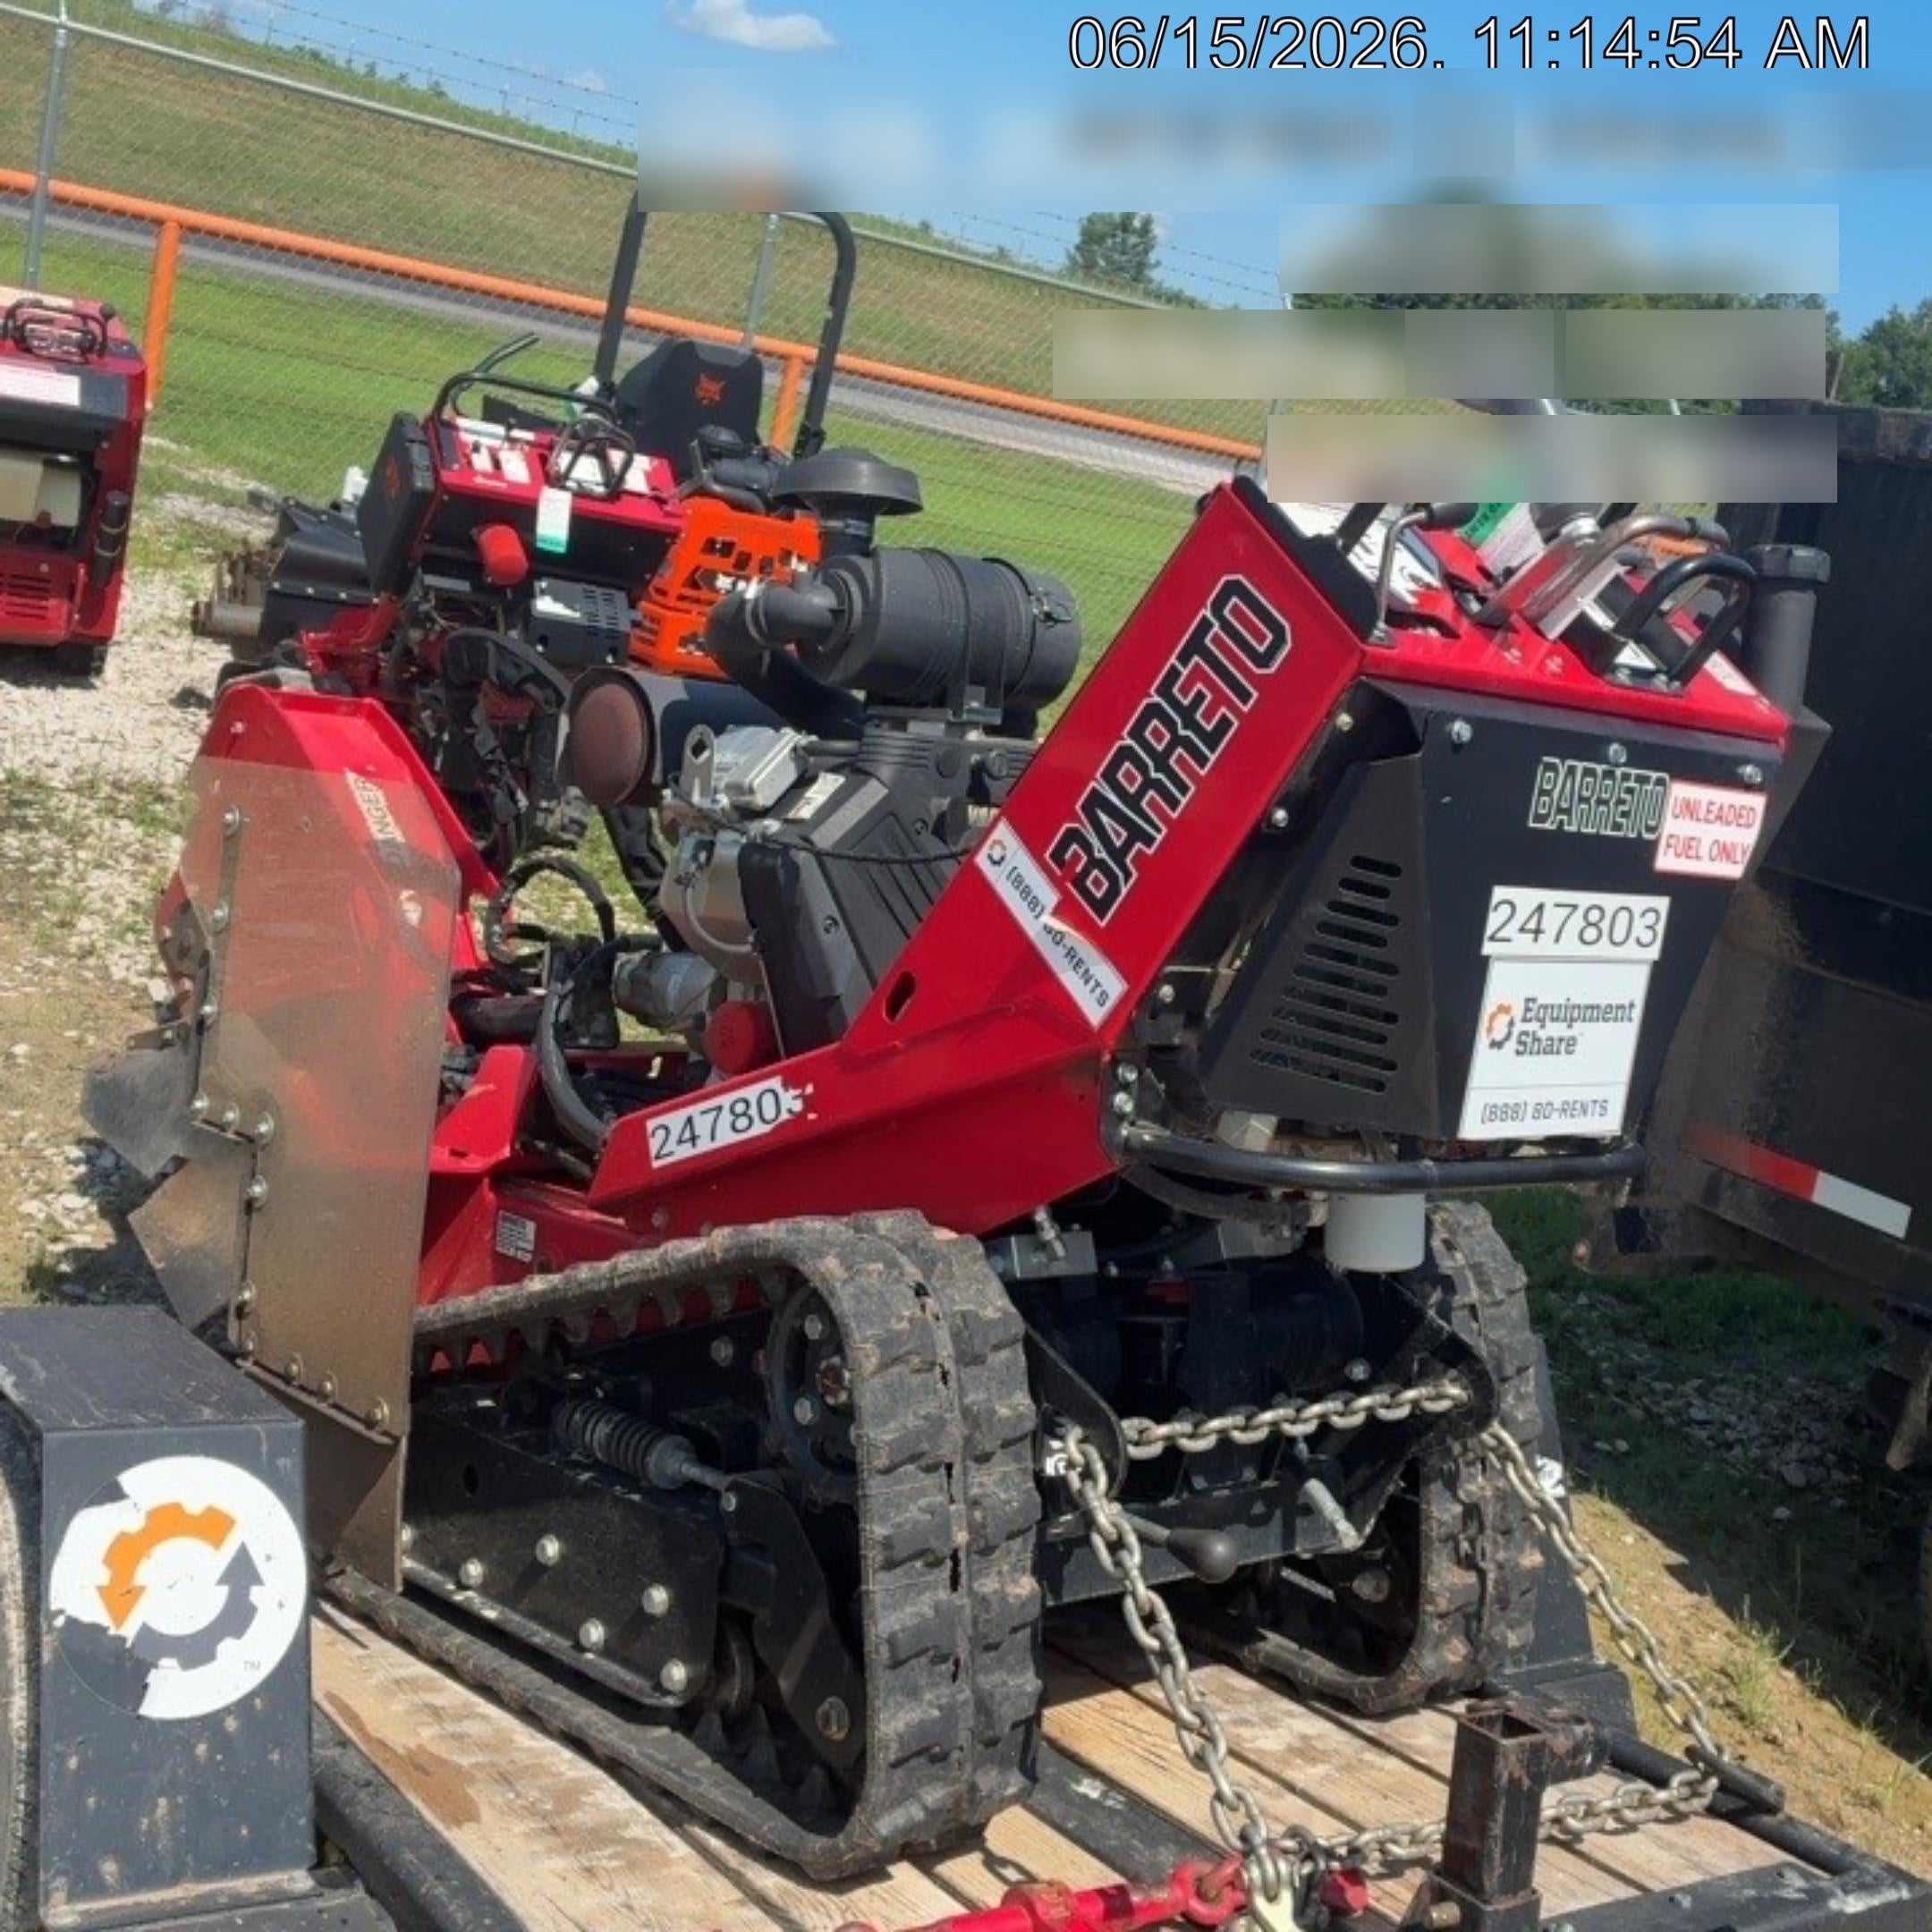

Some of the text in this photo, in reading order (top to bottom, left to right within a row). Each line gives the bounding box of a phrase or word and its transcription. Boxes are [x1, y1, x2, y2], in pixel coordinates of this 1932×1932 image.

[1043, 573, 1292, 928] BARRETO
[1528, 756, 1670, 841] BARRETO
[1671, 795, 1758, 829] UNLEADED
[1664, 833, 1756, 866] FUEL ONLY
[1005, 865, 1046, 921] (888)
[1487, 898, 1662, 948] 247803
[1521, 996, 1636, 1030] Equipment
[1514, 1030, 1579, 1057] Share
[1480, 1100, 1528, 1124] (888)
[242, 1659, 261, 1673] TM
